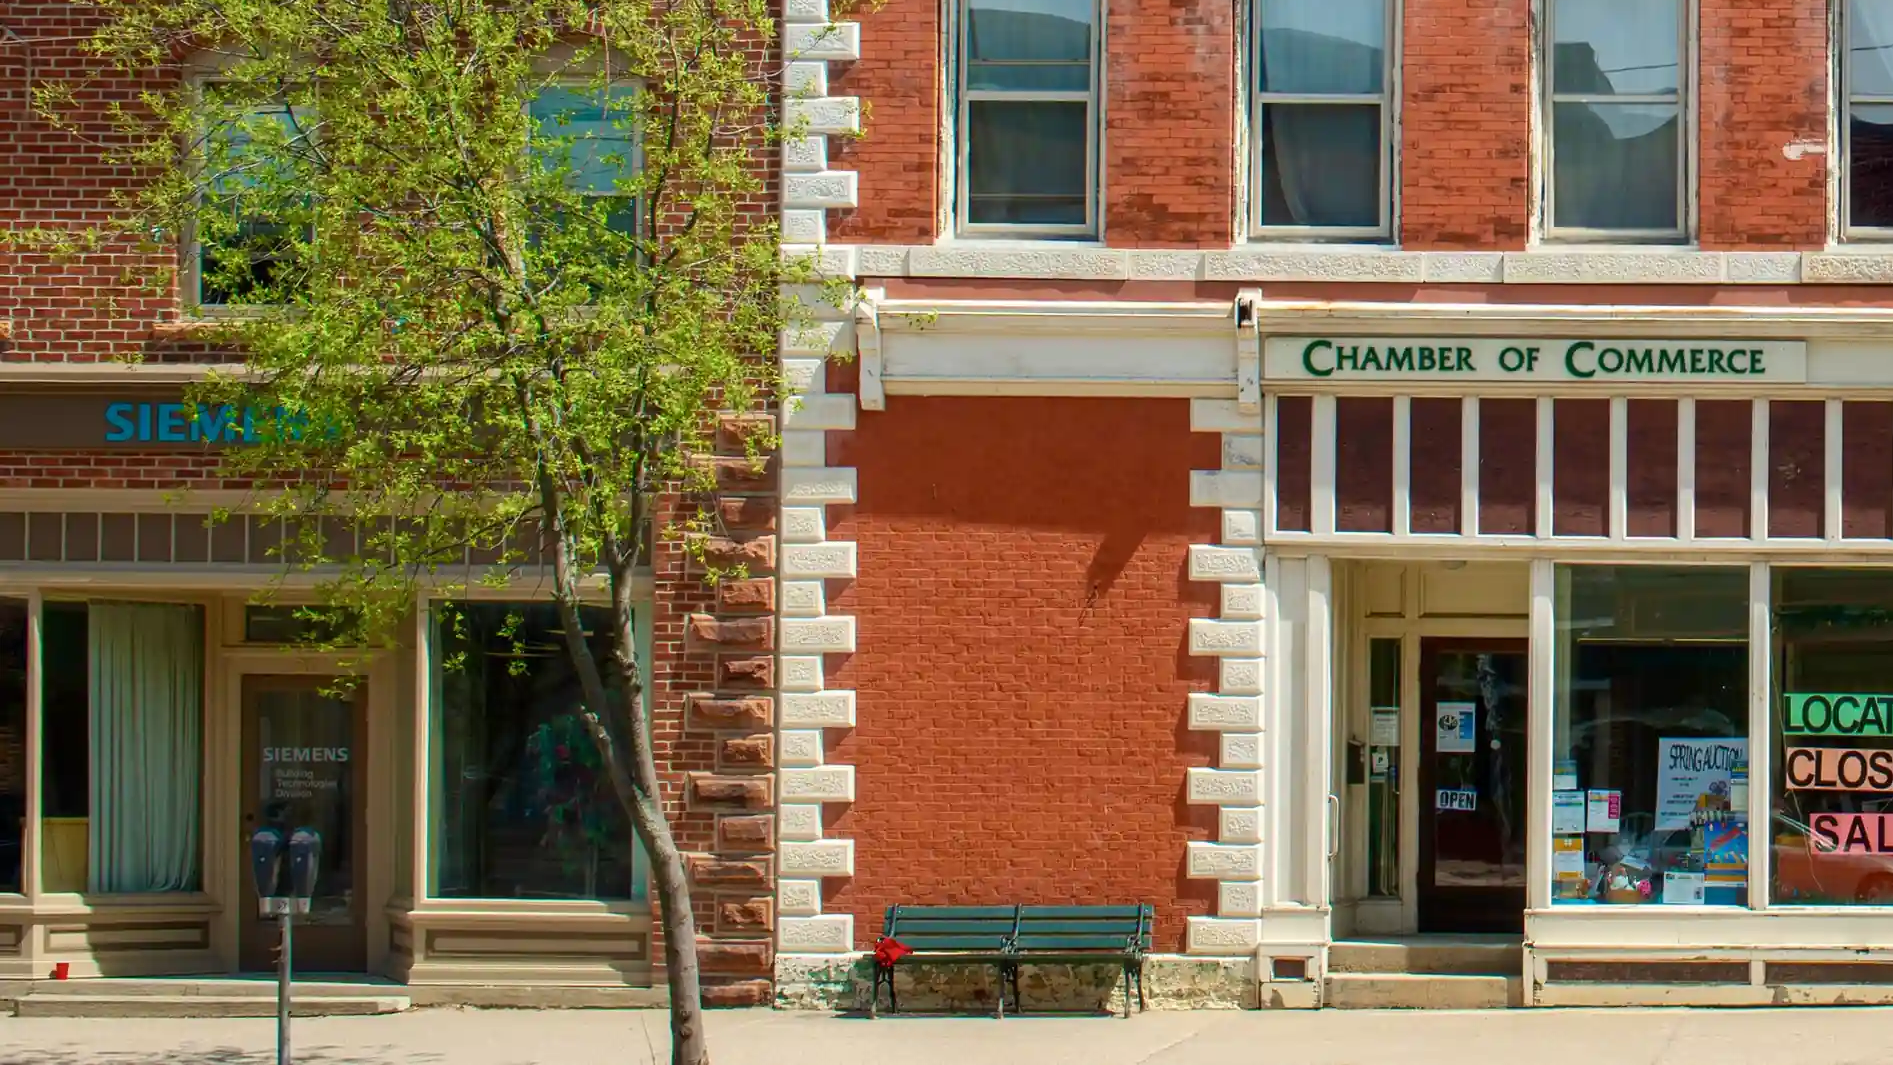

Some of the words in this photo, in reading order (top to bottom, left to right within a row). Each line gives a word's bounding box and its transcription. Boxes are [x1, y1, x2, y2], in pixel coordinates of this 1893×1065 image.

[1302, 339, 1476, 377] CHAMBER
[1499, 346, 1540, 373] OF
[1564, 341, 1766, 378] COMMERCE
[263, 746, 349, 763] SIEMENS
[1668, 742, 1702, 772] SPRING
[1440, 791, 1475, 809] OPEN
